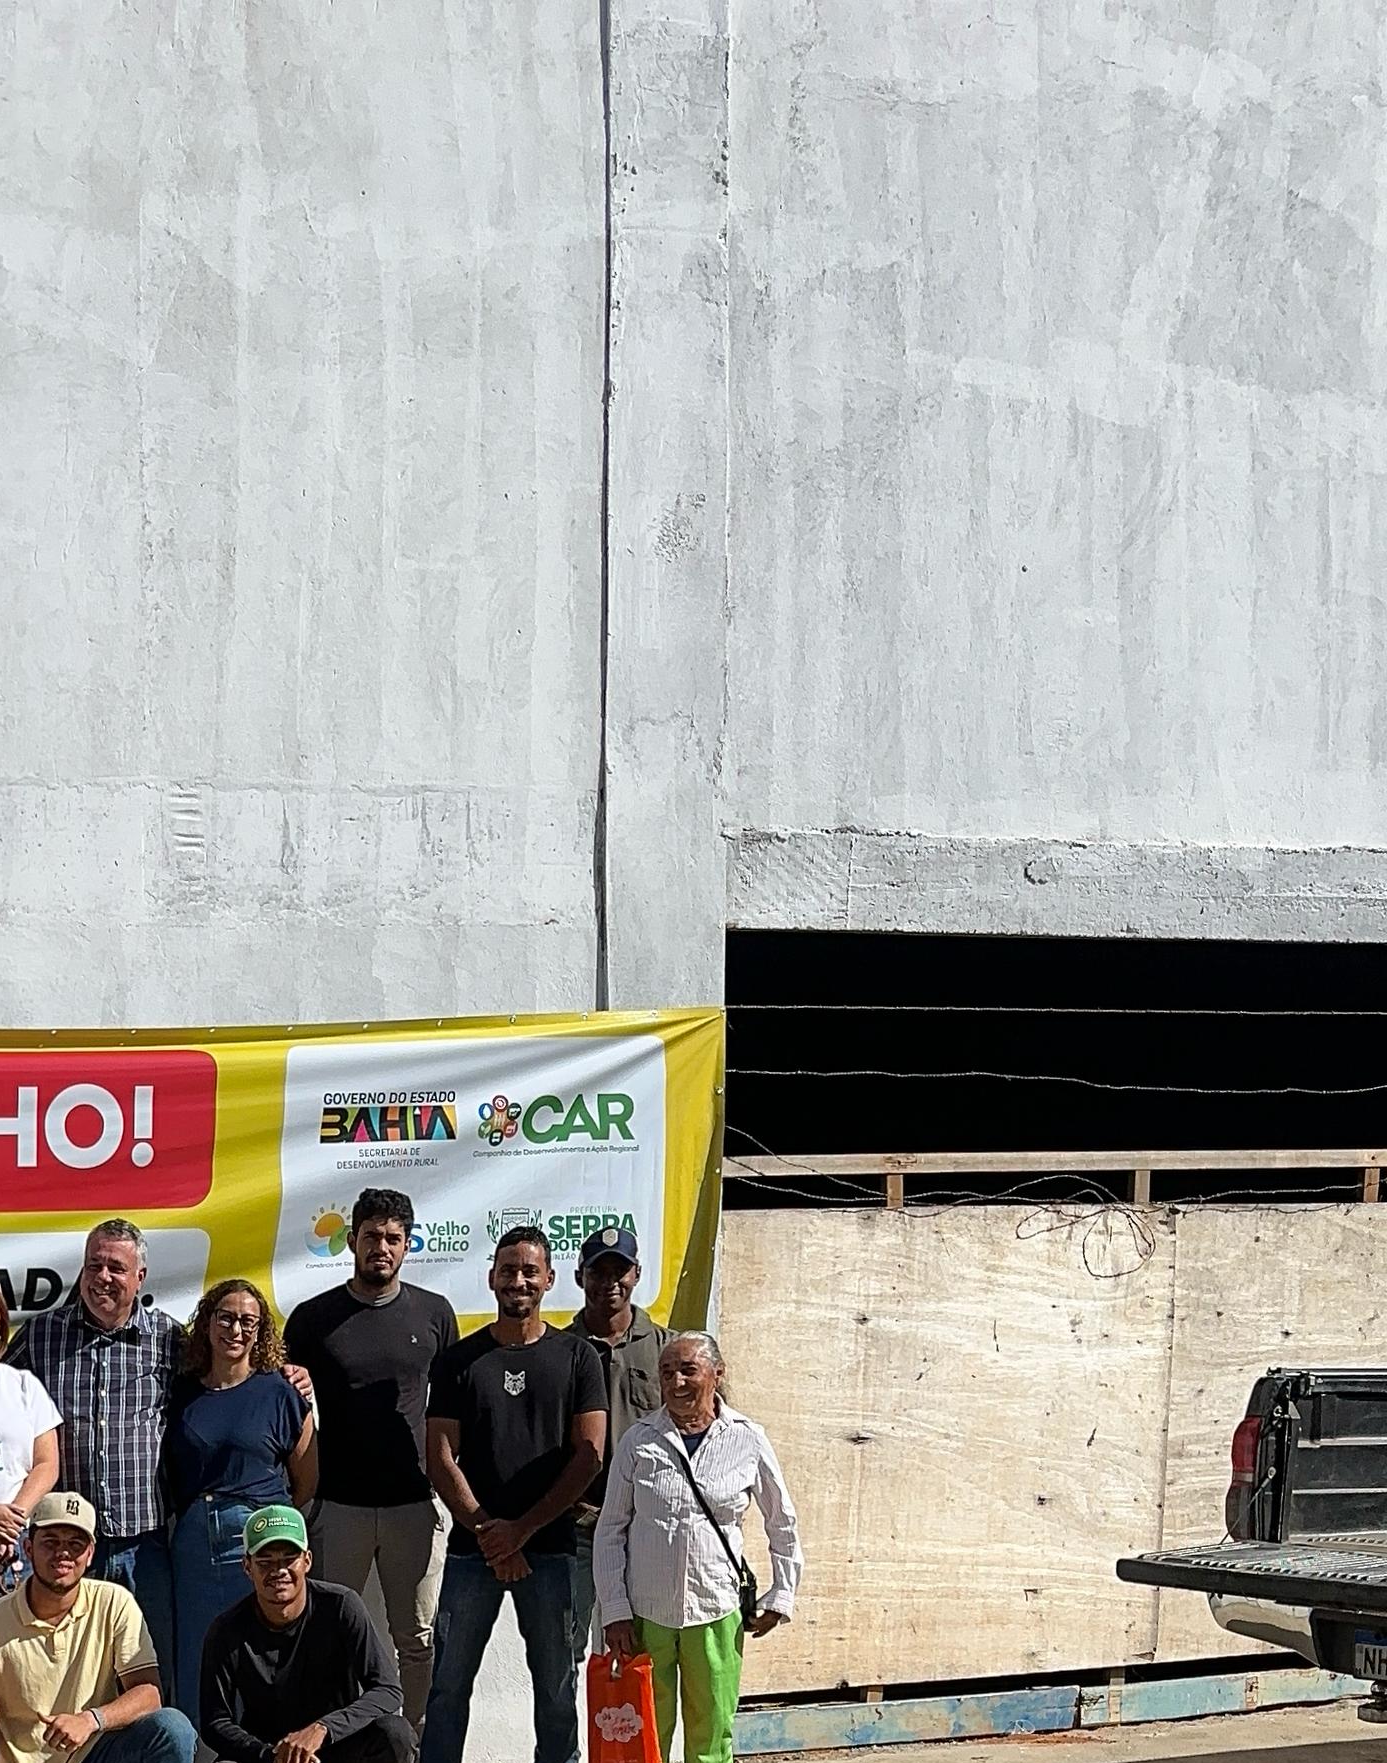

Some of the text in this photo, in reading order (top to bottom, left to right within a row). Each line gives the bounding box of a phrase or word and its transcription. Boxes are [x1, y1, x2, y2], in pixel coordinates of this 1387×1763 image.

[323, 1091, 456, 1105] GOVERNO DO ESTADO
[320, 1105, 457, 1143] BAHIA
[522, 1093, 635, 1144] CAR
[359, 1147, 421, 1157] SECRETARIA DE
[337, 1158, 439, 1169] DESENVOLVIMENTO RURAL
[570, 1205, 618, 1213] PREFEITURA
[426, 1220, 470, 1236] Velho
[428, 1237, 470, 1252] Chico
